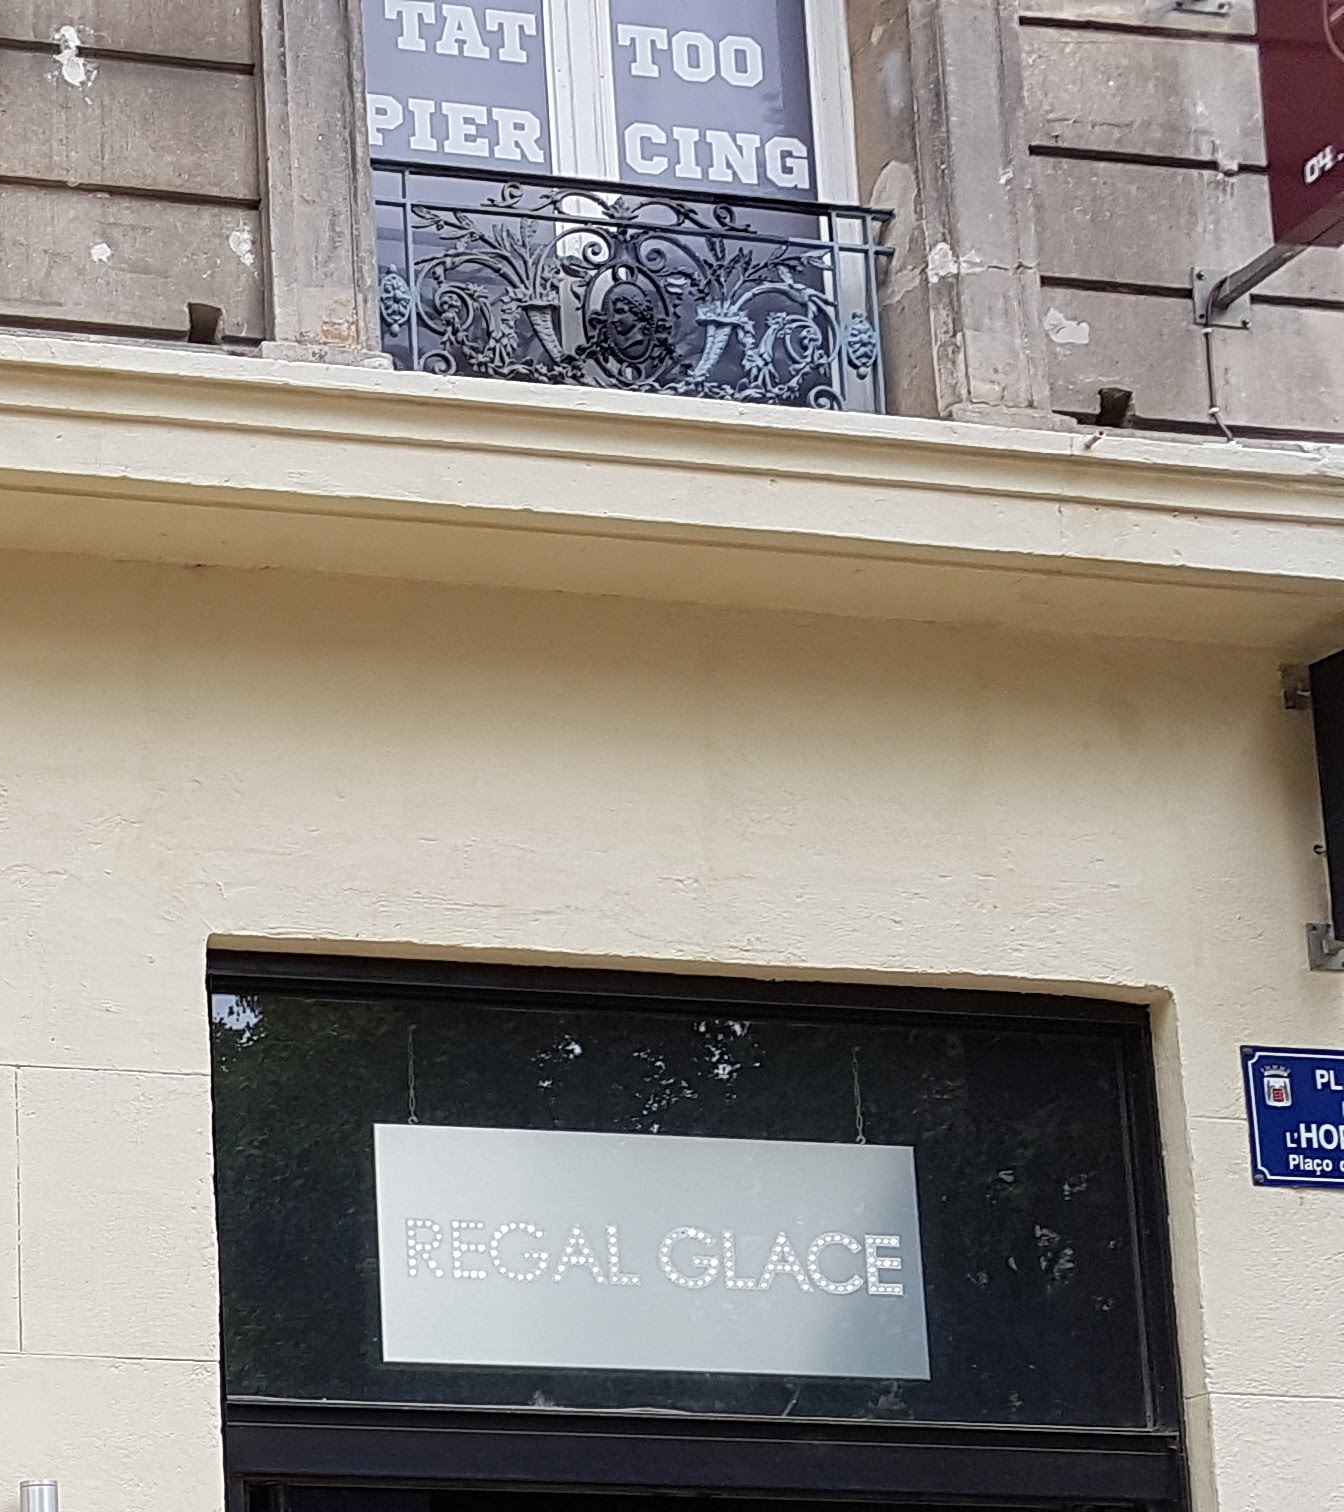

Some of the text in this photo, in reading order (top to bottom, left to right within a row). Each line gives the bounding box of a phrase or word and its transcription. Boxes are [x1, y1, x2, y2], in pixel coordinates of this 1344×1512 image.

[384, 0, 764, 88] TAT TOO
[366, 93, 810, 190] PIER CING
[1289, 1154, 1332, 1175] Plaço
[405, 1217, 904, 1296] REGAL GLACE
